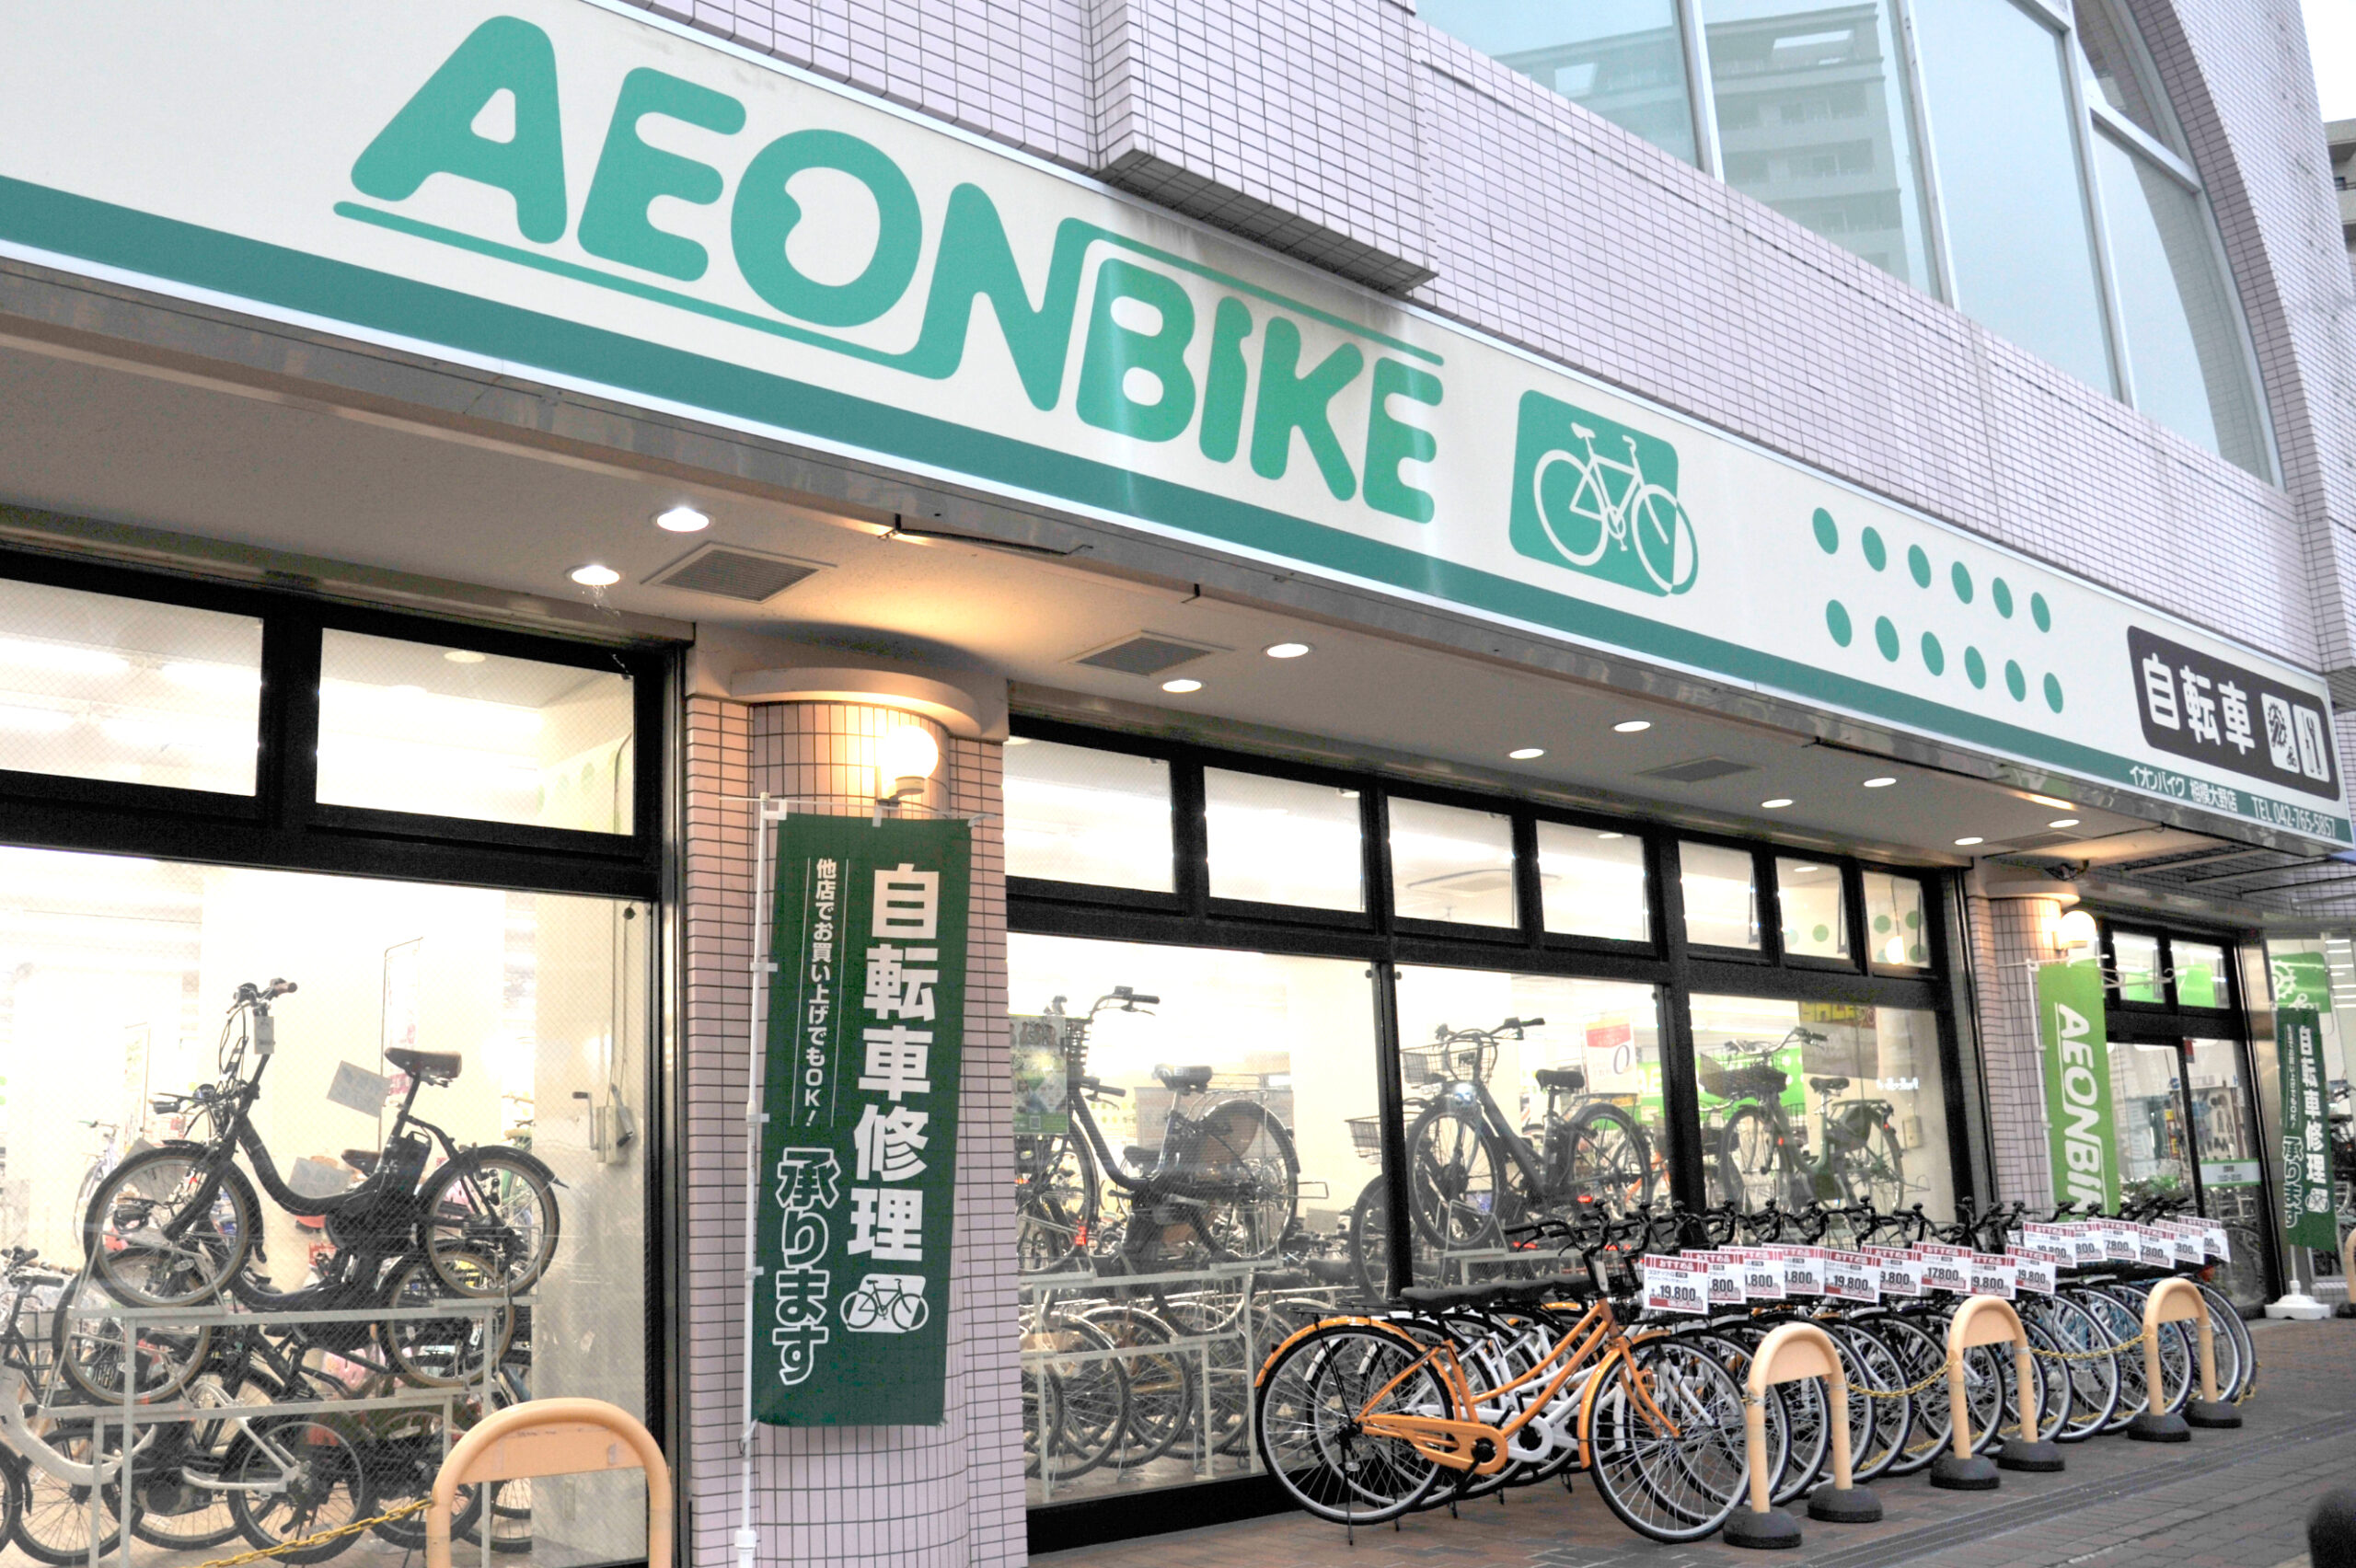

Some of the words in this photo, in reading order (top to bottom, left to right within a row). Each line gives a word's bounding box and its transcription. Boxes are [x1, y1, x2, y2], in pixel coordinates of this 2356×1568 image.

[2142, 651, 2256, 755] 自転車
[2130, 765, 2186, 798] イオンバイク
[2189, 778, 2238, 813] 相模大野店
[2251, 796, 2272, 822] TEL
[2273, 803, 2336, 837] 042-765-5857
[804, 858, 837, 1127] 他店でお買い上げでもOK!
[847, 863, 940, 1262] 自転車修理
[2300, 1024, 2327, 1185] 自転車修理
[2282, 1136, 2304, 1228] 承ります
[772, 1147, 840, 1386] 承ります
[1658, 1259, 1694, 1271] おすすめ品
